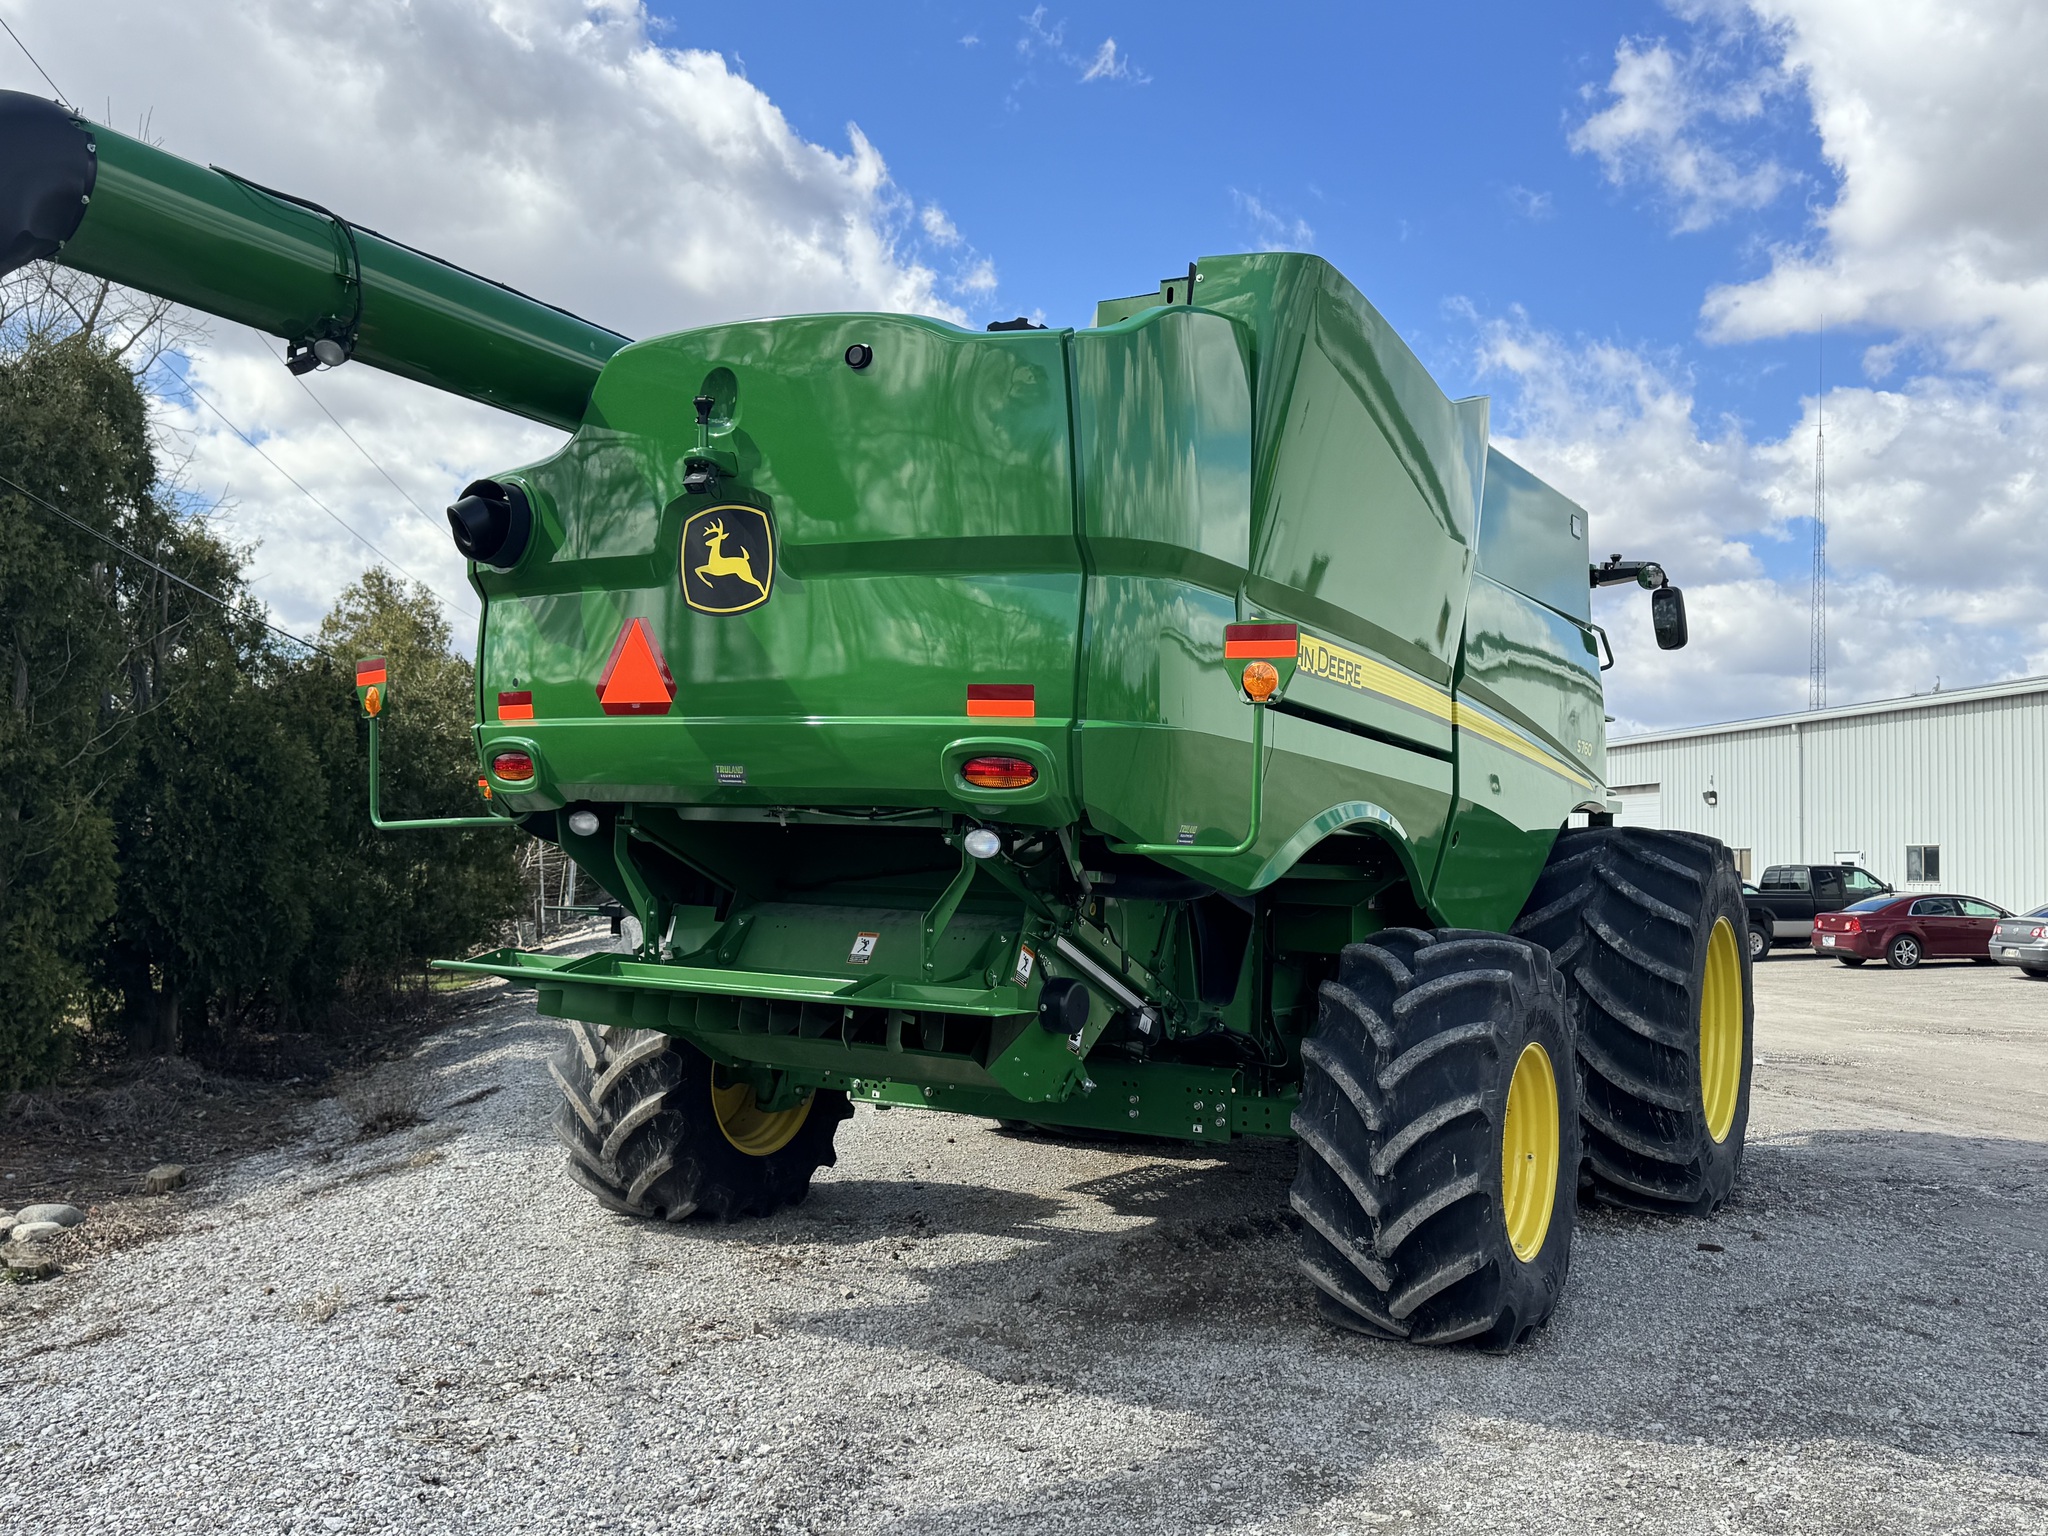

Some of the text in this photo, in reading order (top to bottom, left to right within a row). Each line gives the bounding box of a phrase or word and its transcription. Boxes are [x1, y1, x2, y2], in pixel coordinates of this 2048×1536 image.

[1317, 646, 1362, 686] DEERE
[1577, 739, 1593, 757] S760
[715, 765, 744, 774] TRULAND
